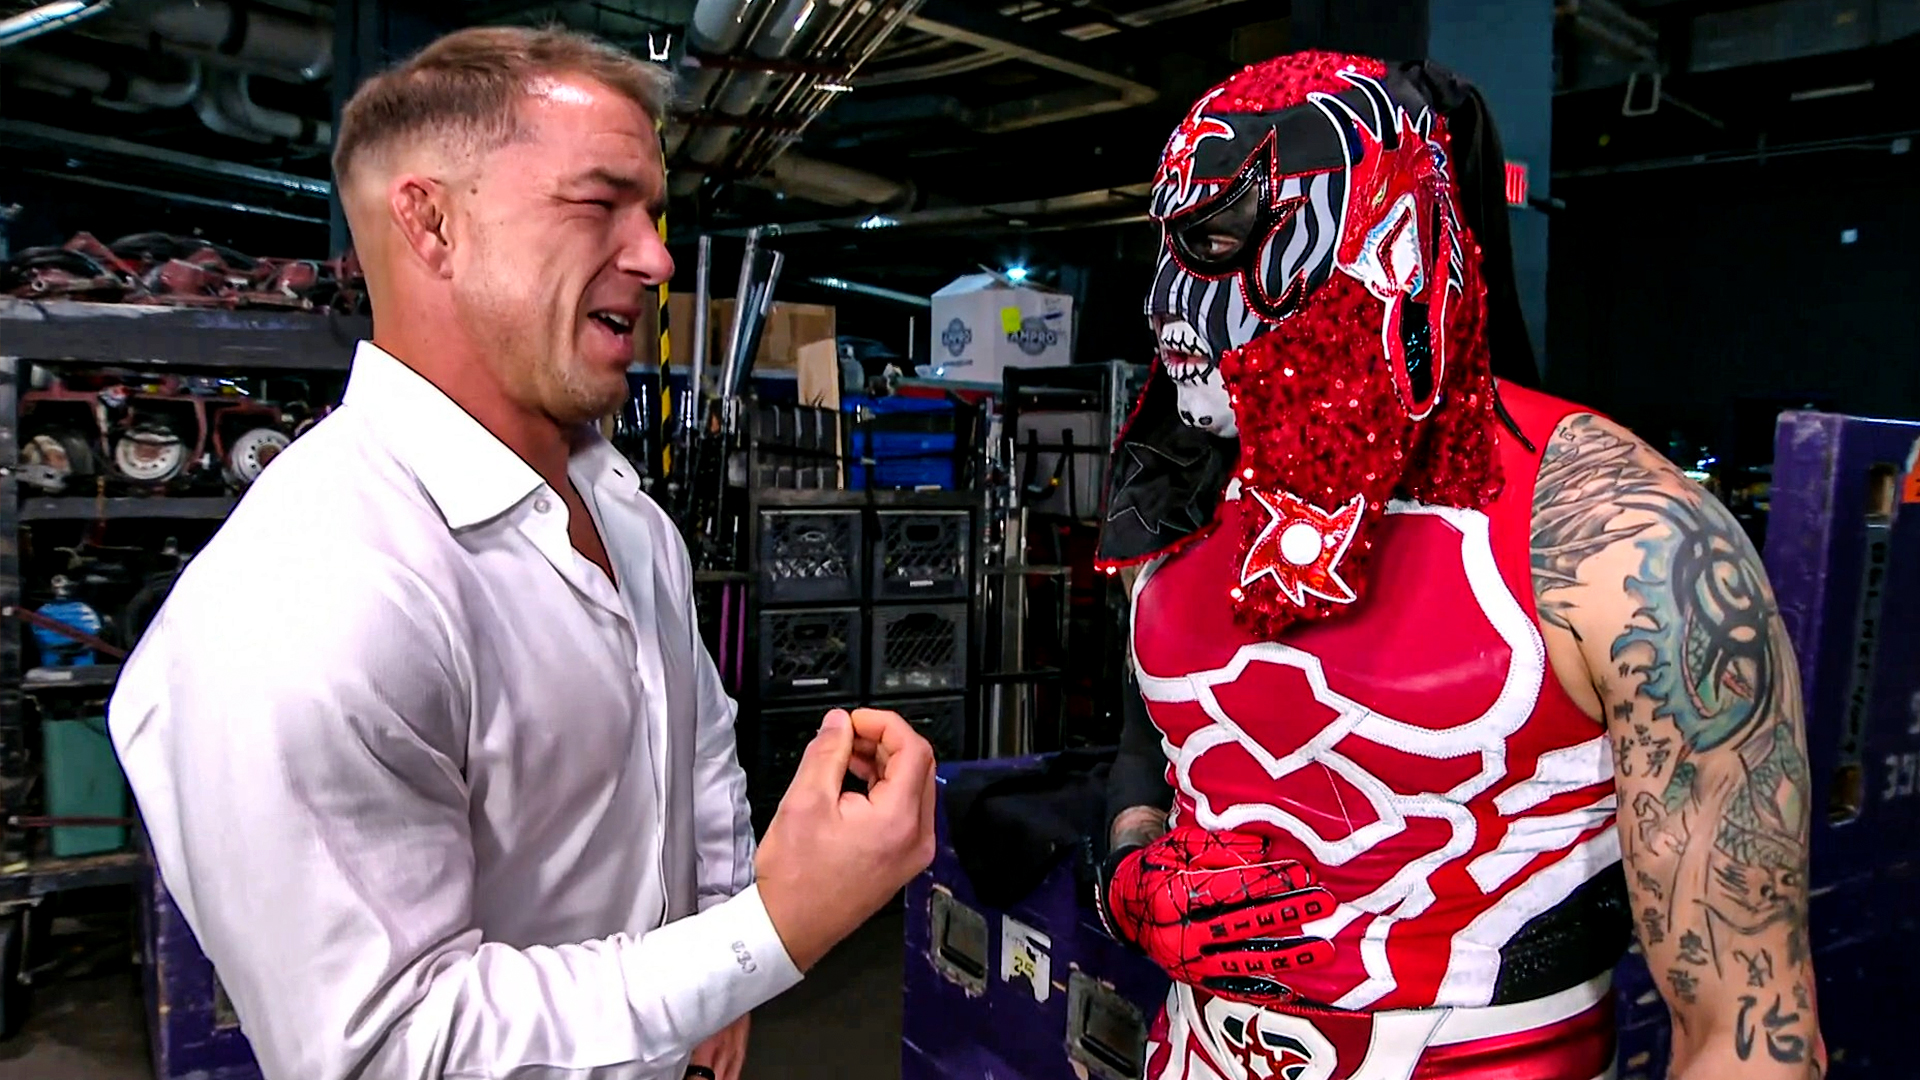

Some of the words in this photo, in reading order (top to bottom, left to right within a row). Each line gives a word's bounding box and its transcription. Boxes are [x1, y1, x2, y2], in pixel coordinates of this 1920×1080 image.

[1009, 331, 1056, 344] AMPRO
[1209, 900, 1322, 939] MIEDO
[1221, 952, 1325, 972] CERO
